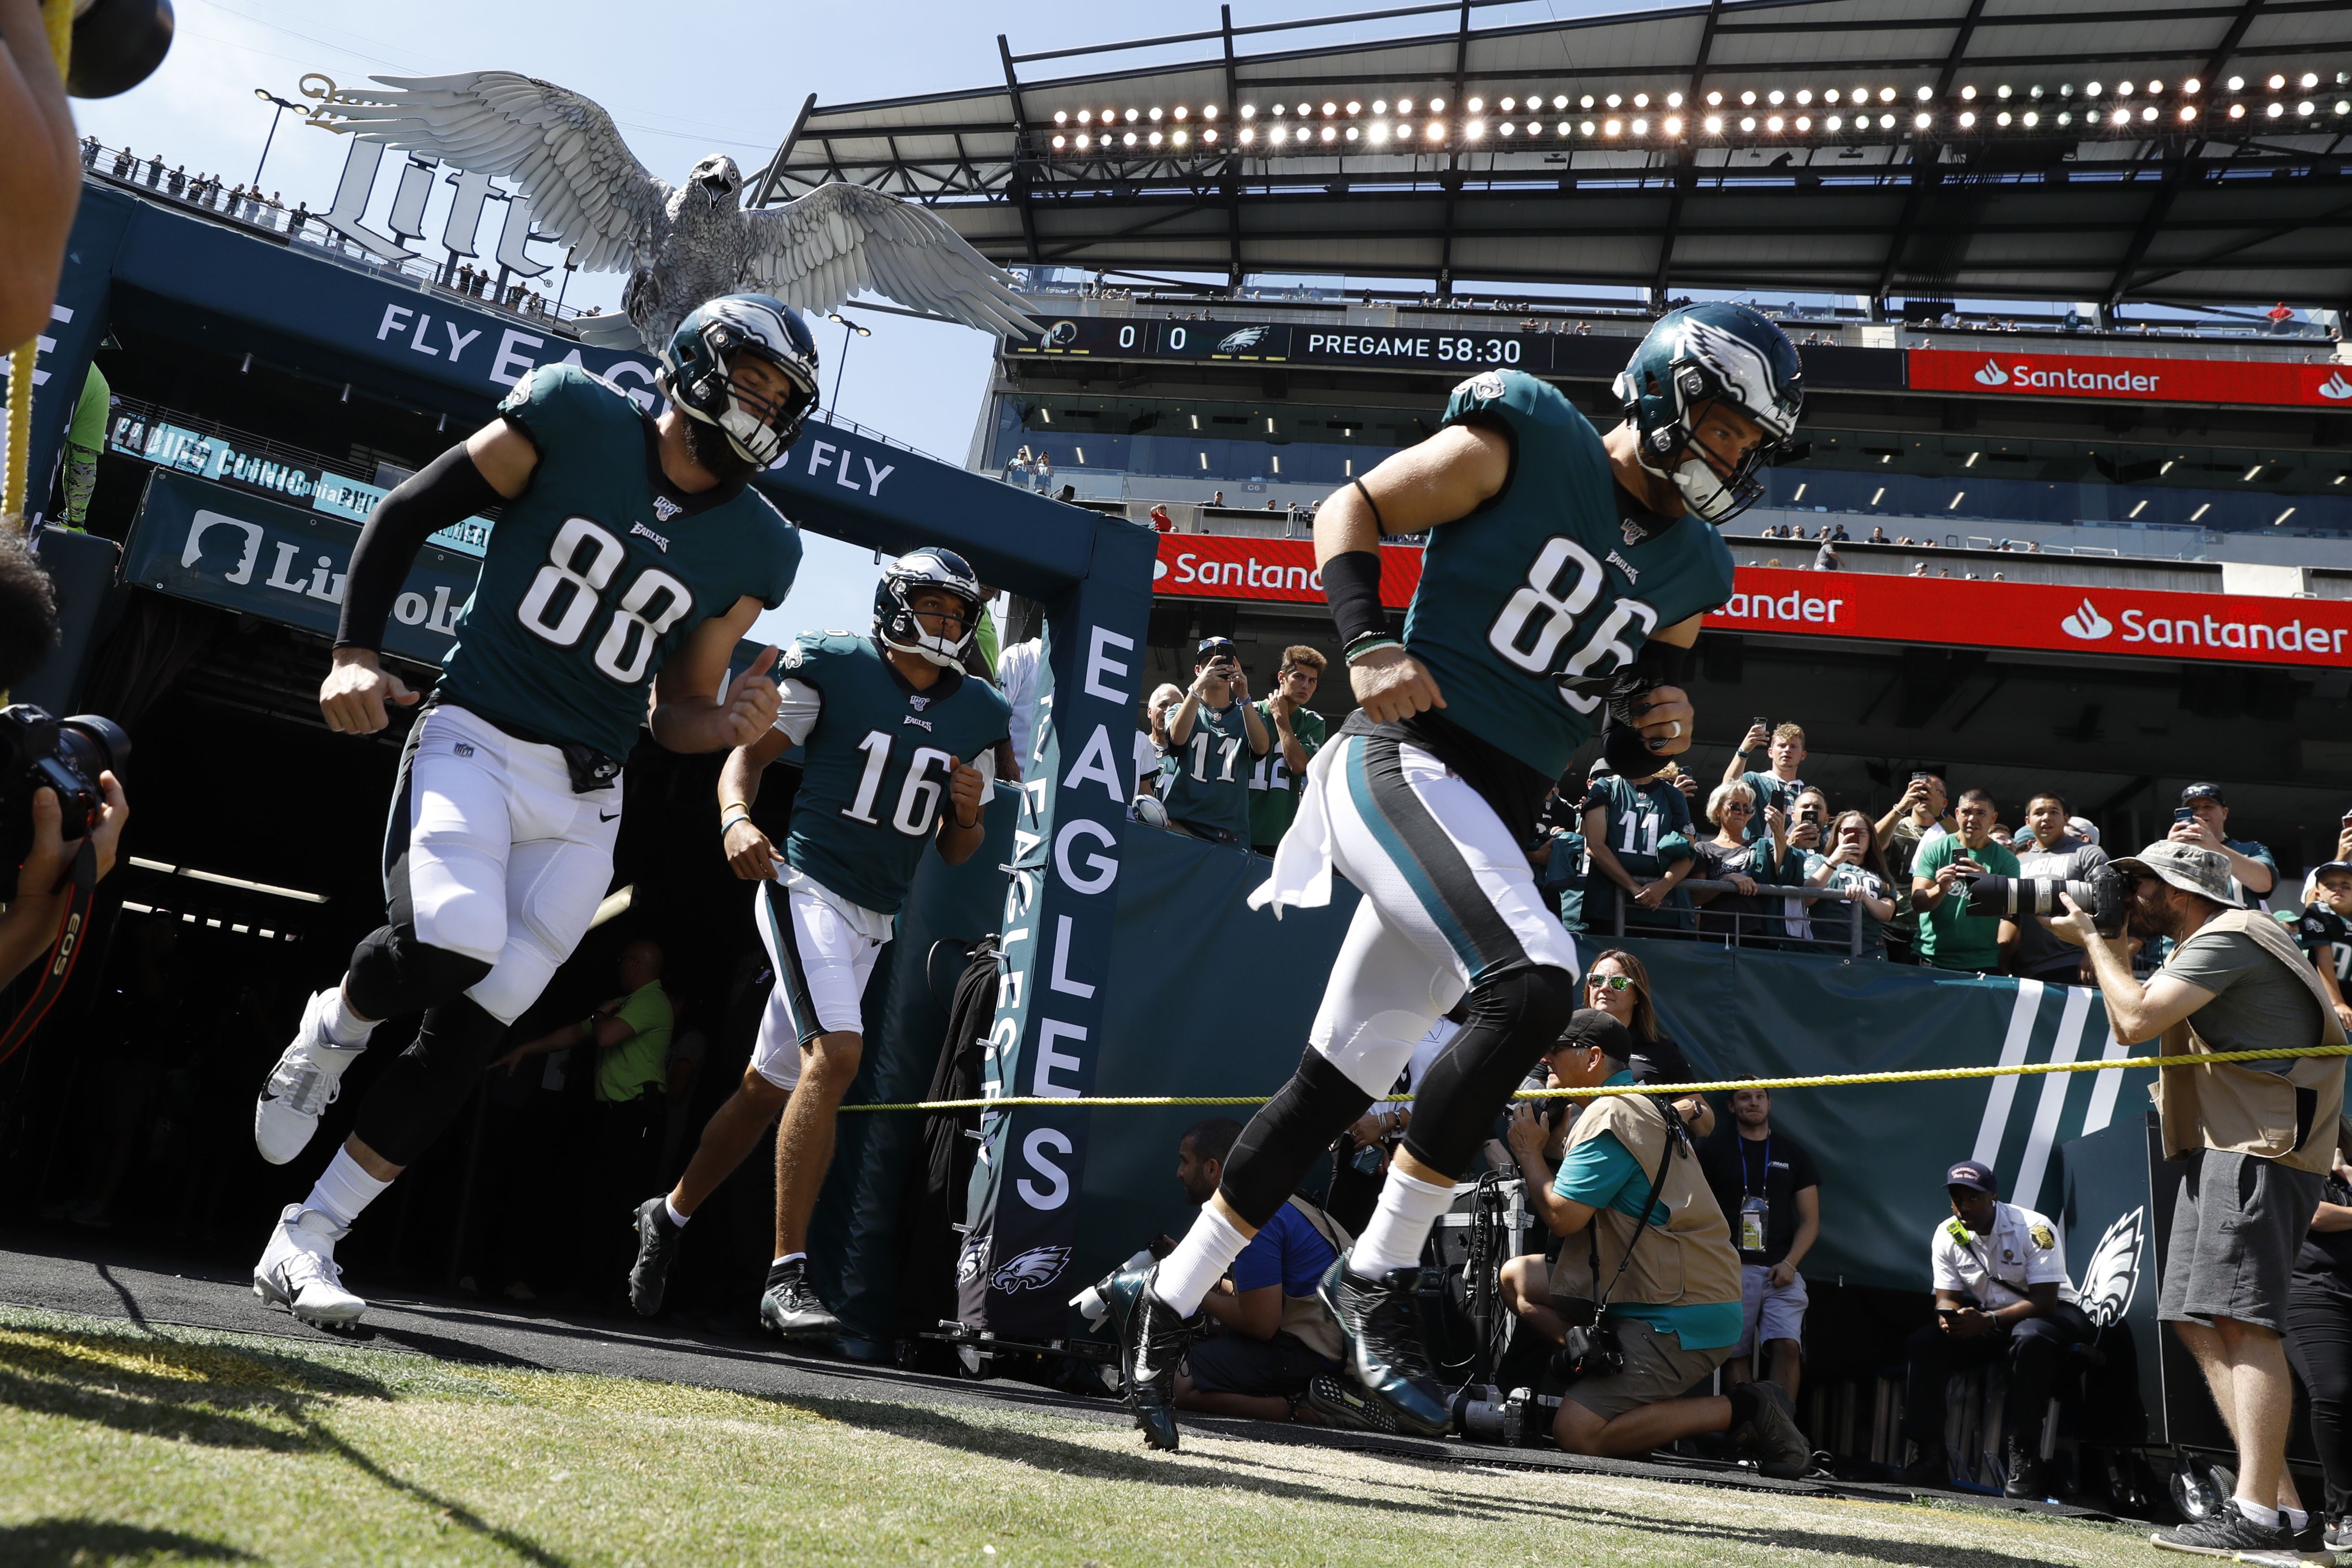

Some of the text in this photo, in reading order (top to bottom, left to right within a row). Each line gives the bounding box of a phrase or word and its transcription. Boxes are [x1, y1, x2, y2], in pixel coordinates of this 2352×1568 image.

[312, 132, 562, 277] Lite
[1119, 326, 1135, 348] 0
[1170, 327, 1186, 350] 0
[1309, 335, 1521, 364] PREGAME 58:30
[377, 304, 482, 362] FLY
[808, 439, 895, 497] FLY
[2013, 365, 2160, 392] Santander
[629, 521, 671, 553] EAGLES
[265, 541, 463, 637] Liol
[1175, 553, 1324, 590] Santan
[517, 516, 694, 685] 88
[1712, 590, 1843, 623] ander
[1489, 536, 1659, 715] 86
[2121, 609, 2349, 653] Santander
[903, 715, 932, 732] EAGLES
[1190, 732, 1235, 783] 11
[1248, 739, 1291, 791] 12
[841, 730, 952, 836] 16
[1618, 810, 1659, 856] 11
[1017, 625, 1135, 1211] EAGLES
[53, 913, 81, 976] EOS
